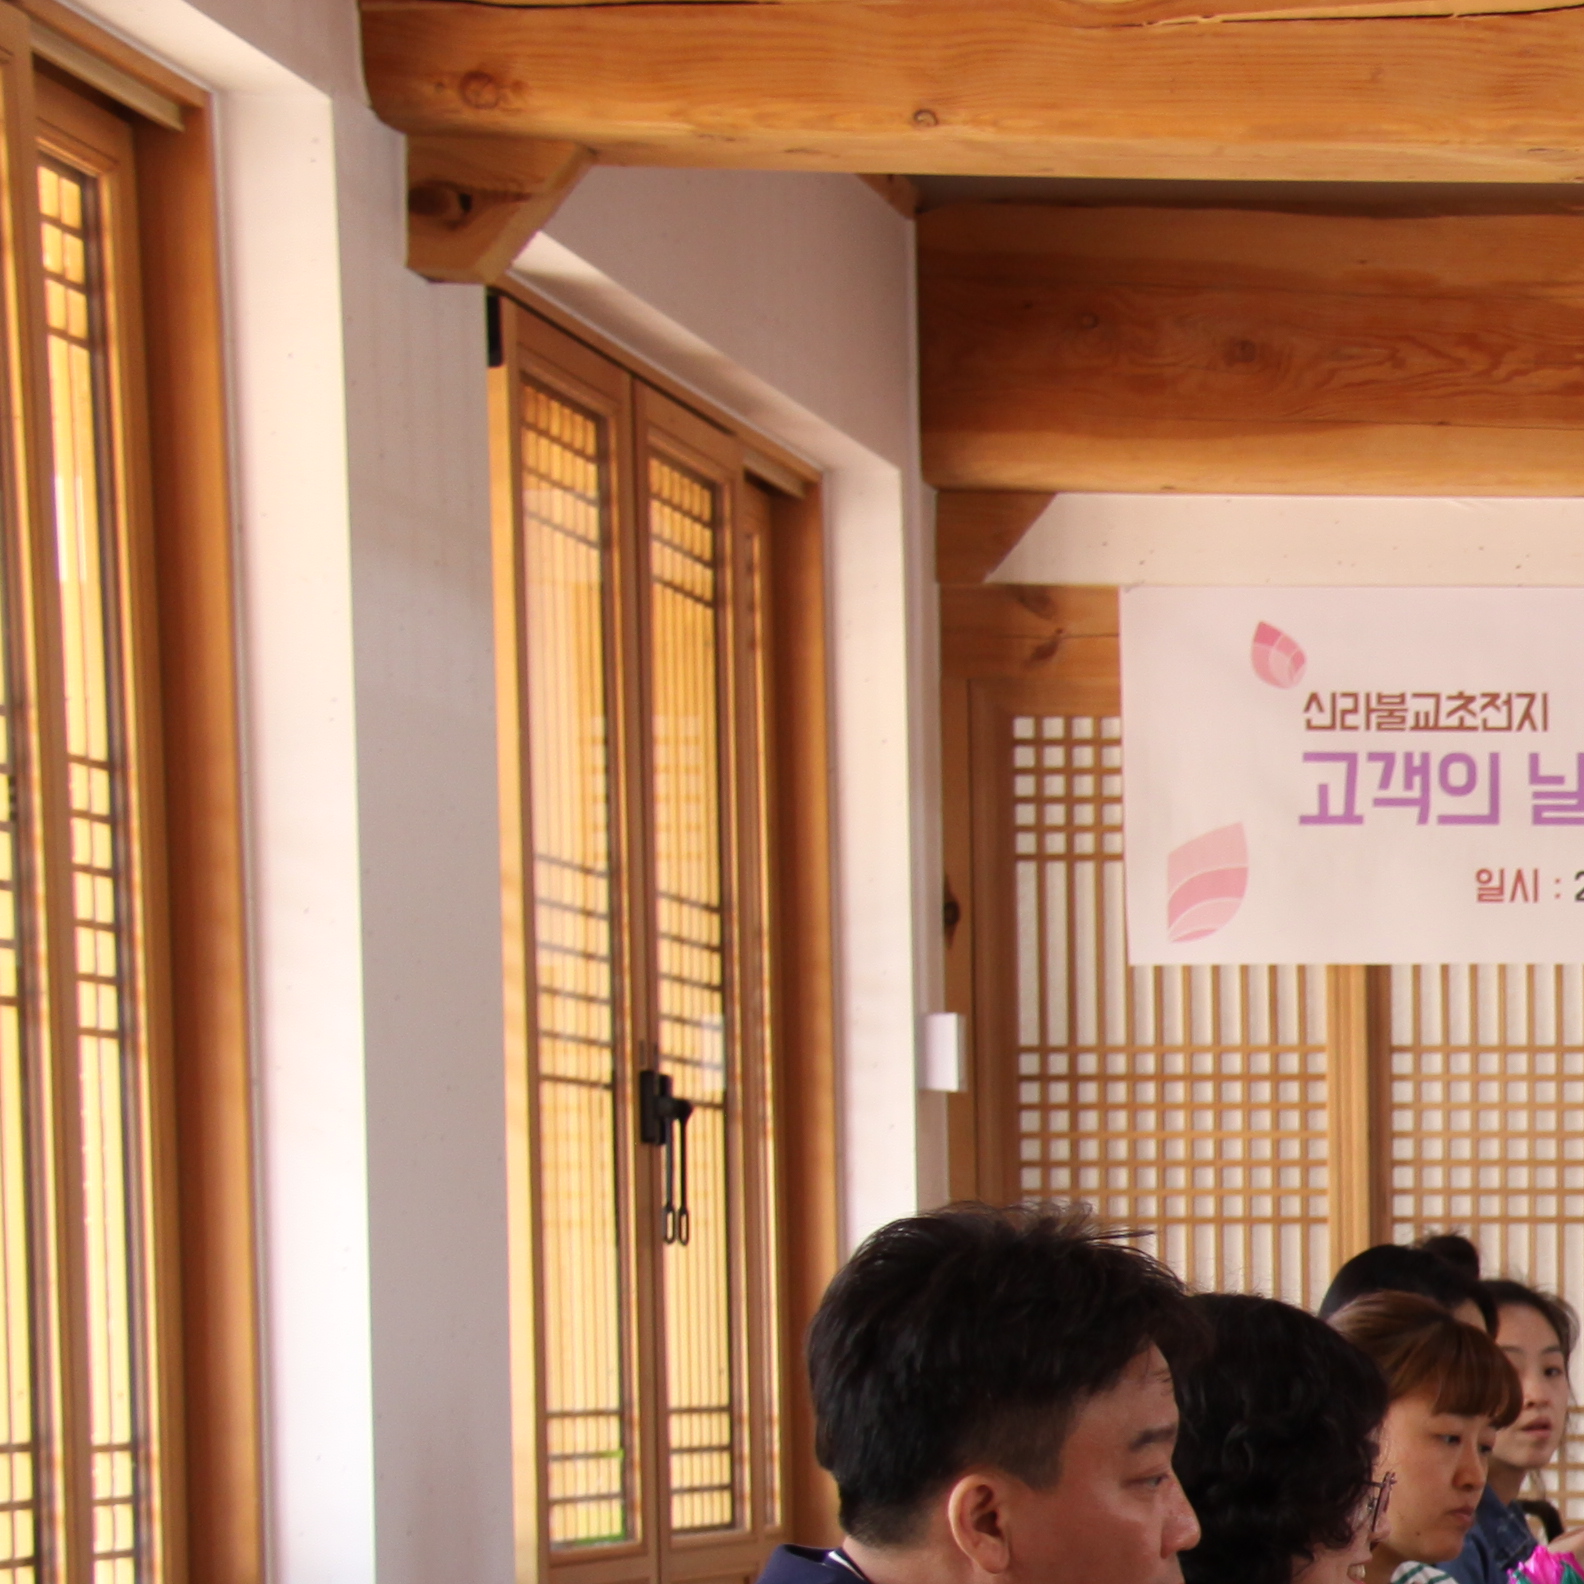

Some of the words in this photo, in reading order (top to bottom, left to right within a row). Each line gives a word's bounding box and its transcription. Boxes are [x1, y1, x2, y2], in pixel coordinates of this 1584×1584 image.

[1303, 690, 1549, 733] 신라불교초전지
[1299, 751, 1501, 826] 고객의
[1475, 868, 1539, 903] 일시
